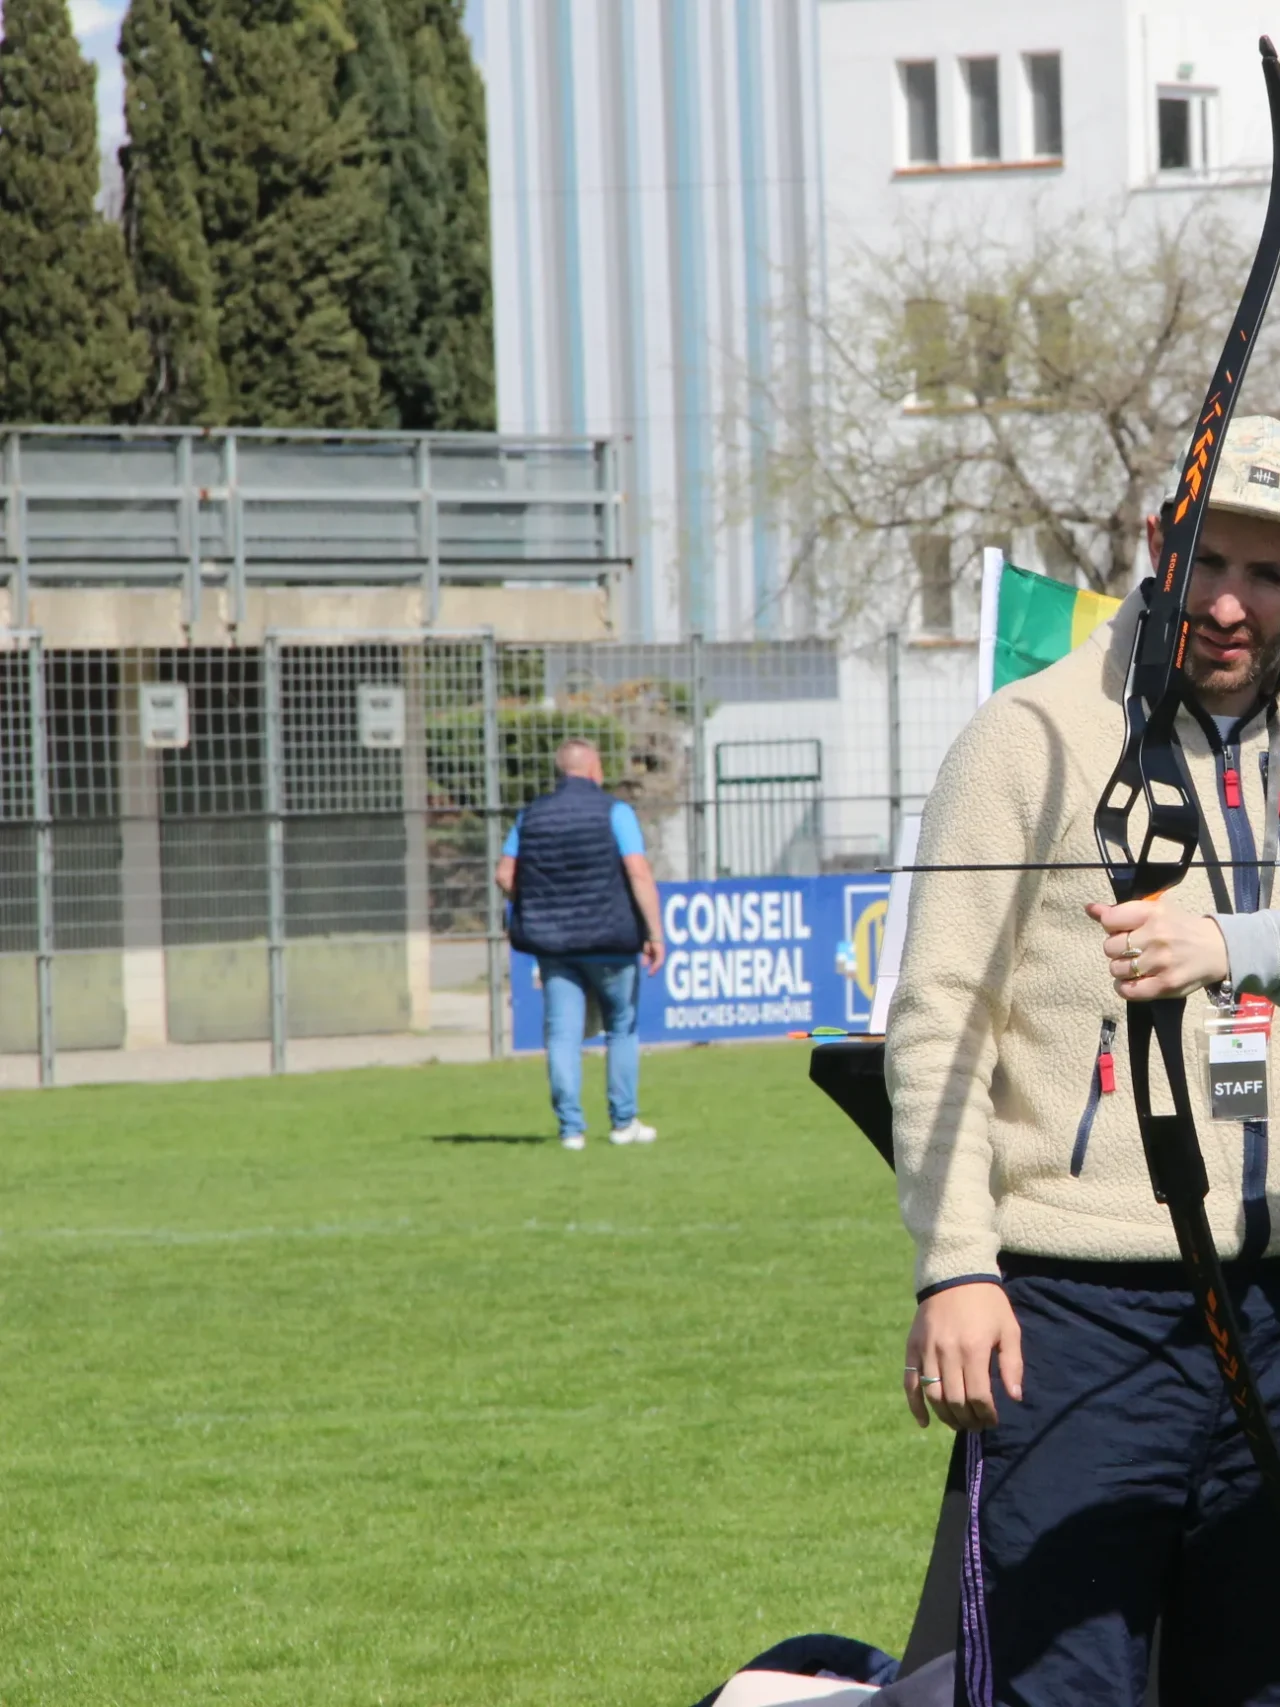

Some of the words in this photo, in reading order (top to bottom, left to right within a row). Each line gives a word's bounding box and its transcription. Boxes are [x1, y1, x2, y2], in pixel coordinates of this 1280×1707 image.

[1164, 552, 1178, 593] GEOLOGIC
[1176, 633, 1186, 669] DISCOVERY
[664, 891, 811, 945] CONSEIL
[665, 947, 812, 1001] GENERAL
[665, 996, 812, 1029] BOUCHES-DU-RHÔNE
[1214, 1081, 1264, 1096] STAFF
